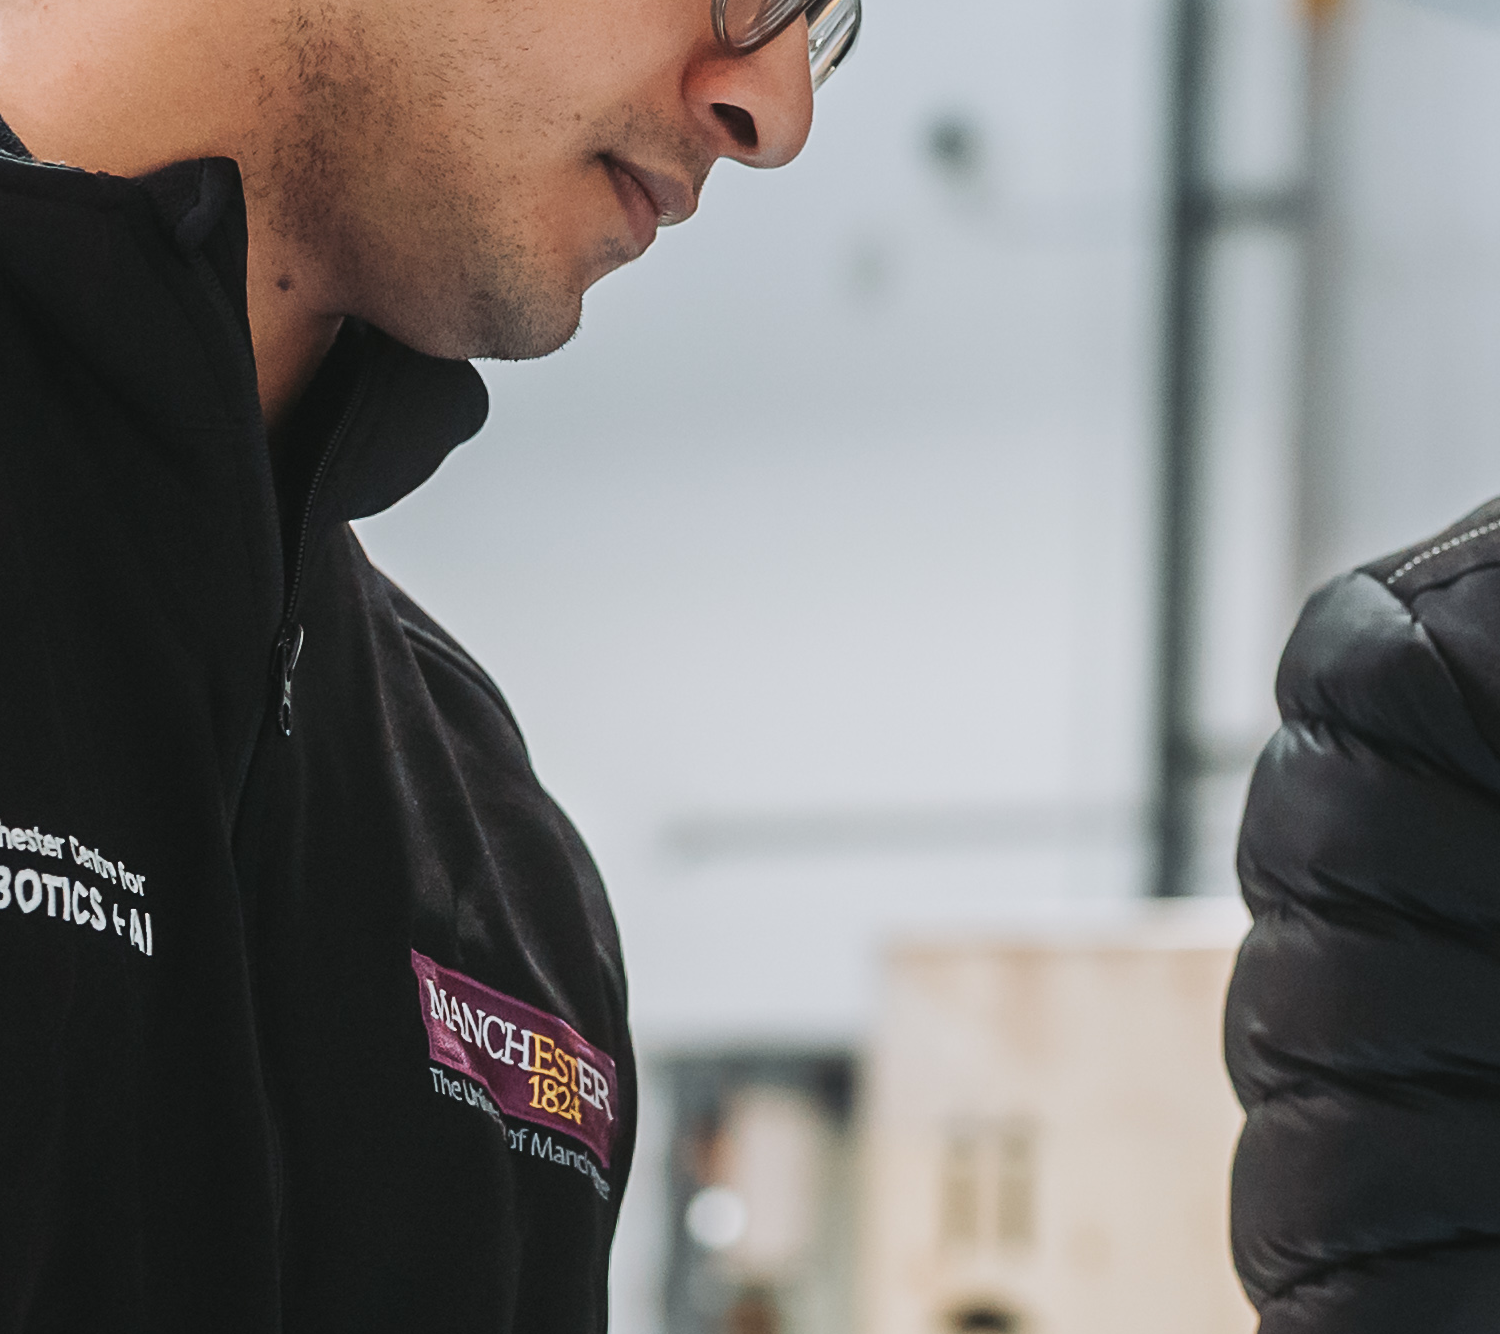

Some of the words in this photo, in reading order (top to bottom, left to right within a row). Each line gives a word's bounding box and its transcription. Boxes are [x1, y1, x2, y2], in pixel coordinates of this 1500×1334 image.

[117, 860, 146, 897] for
[129, 908, 153, 956] AI
[426, 978, 615, 1121] MANCHESTER
[429, 1066, 463, 1101] The
[528, 1074, 582, 1125] 1824
